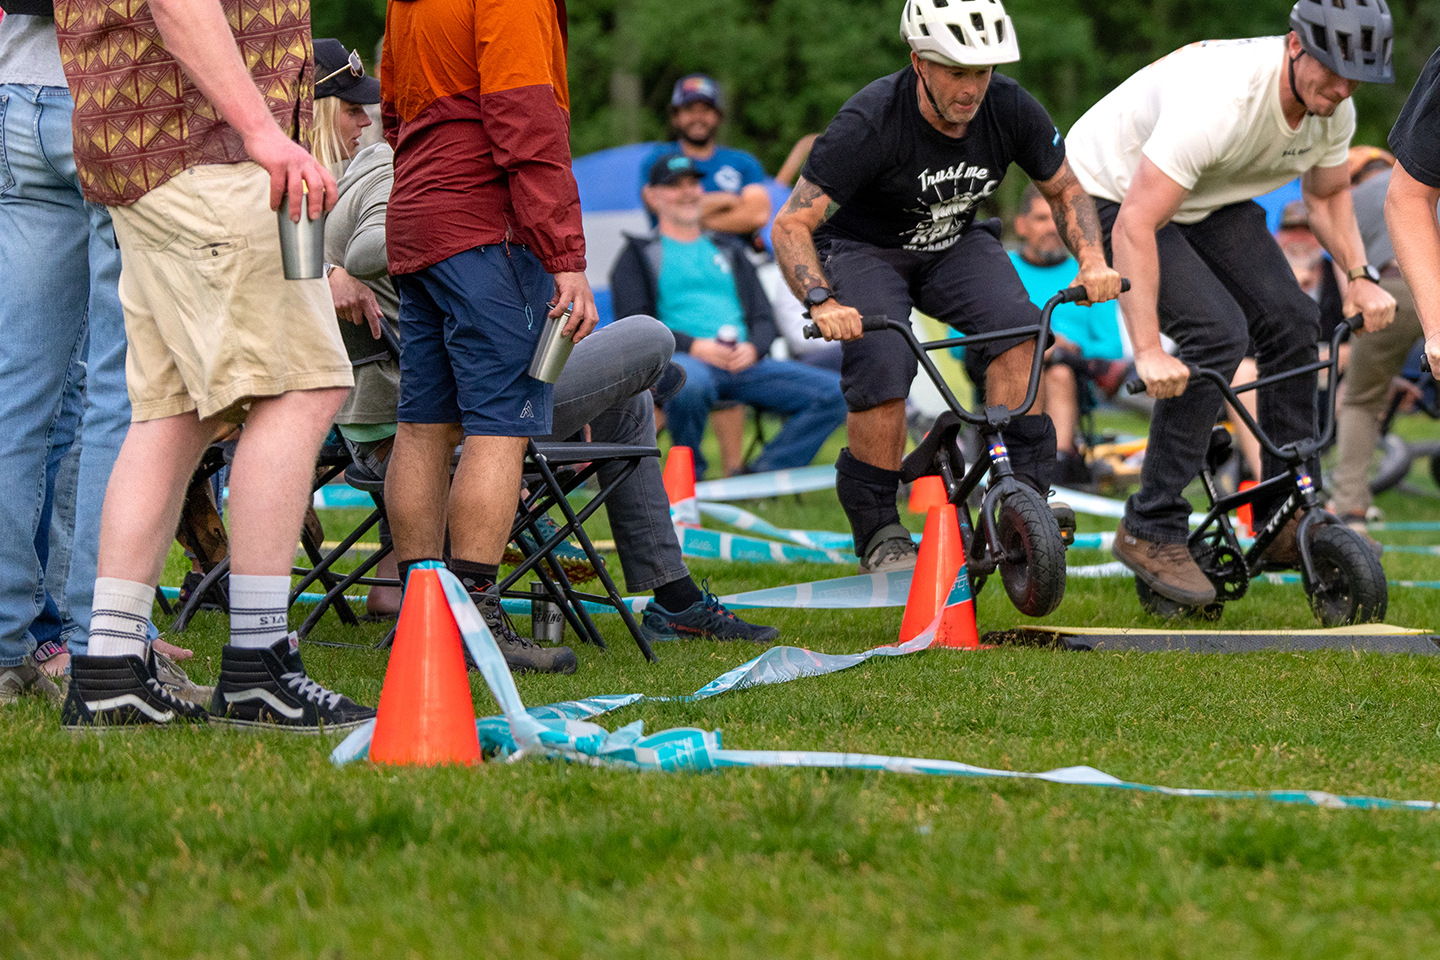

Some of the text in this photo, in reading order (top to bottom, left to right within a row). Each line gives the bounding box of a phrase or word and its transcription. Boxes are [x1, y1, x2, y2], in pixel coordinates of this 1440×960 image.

[917, 161, 988, 192] Trust me
[1266, 494, 1294, 534] YETI
